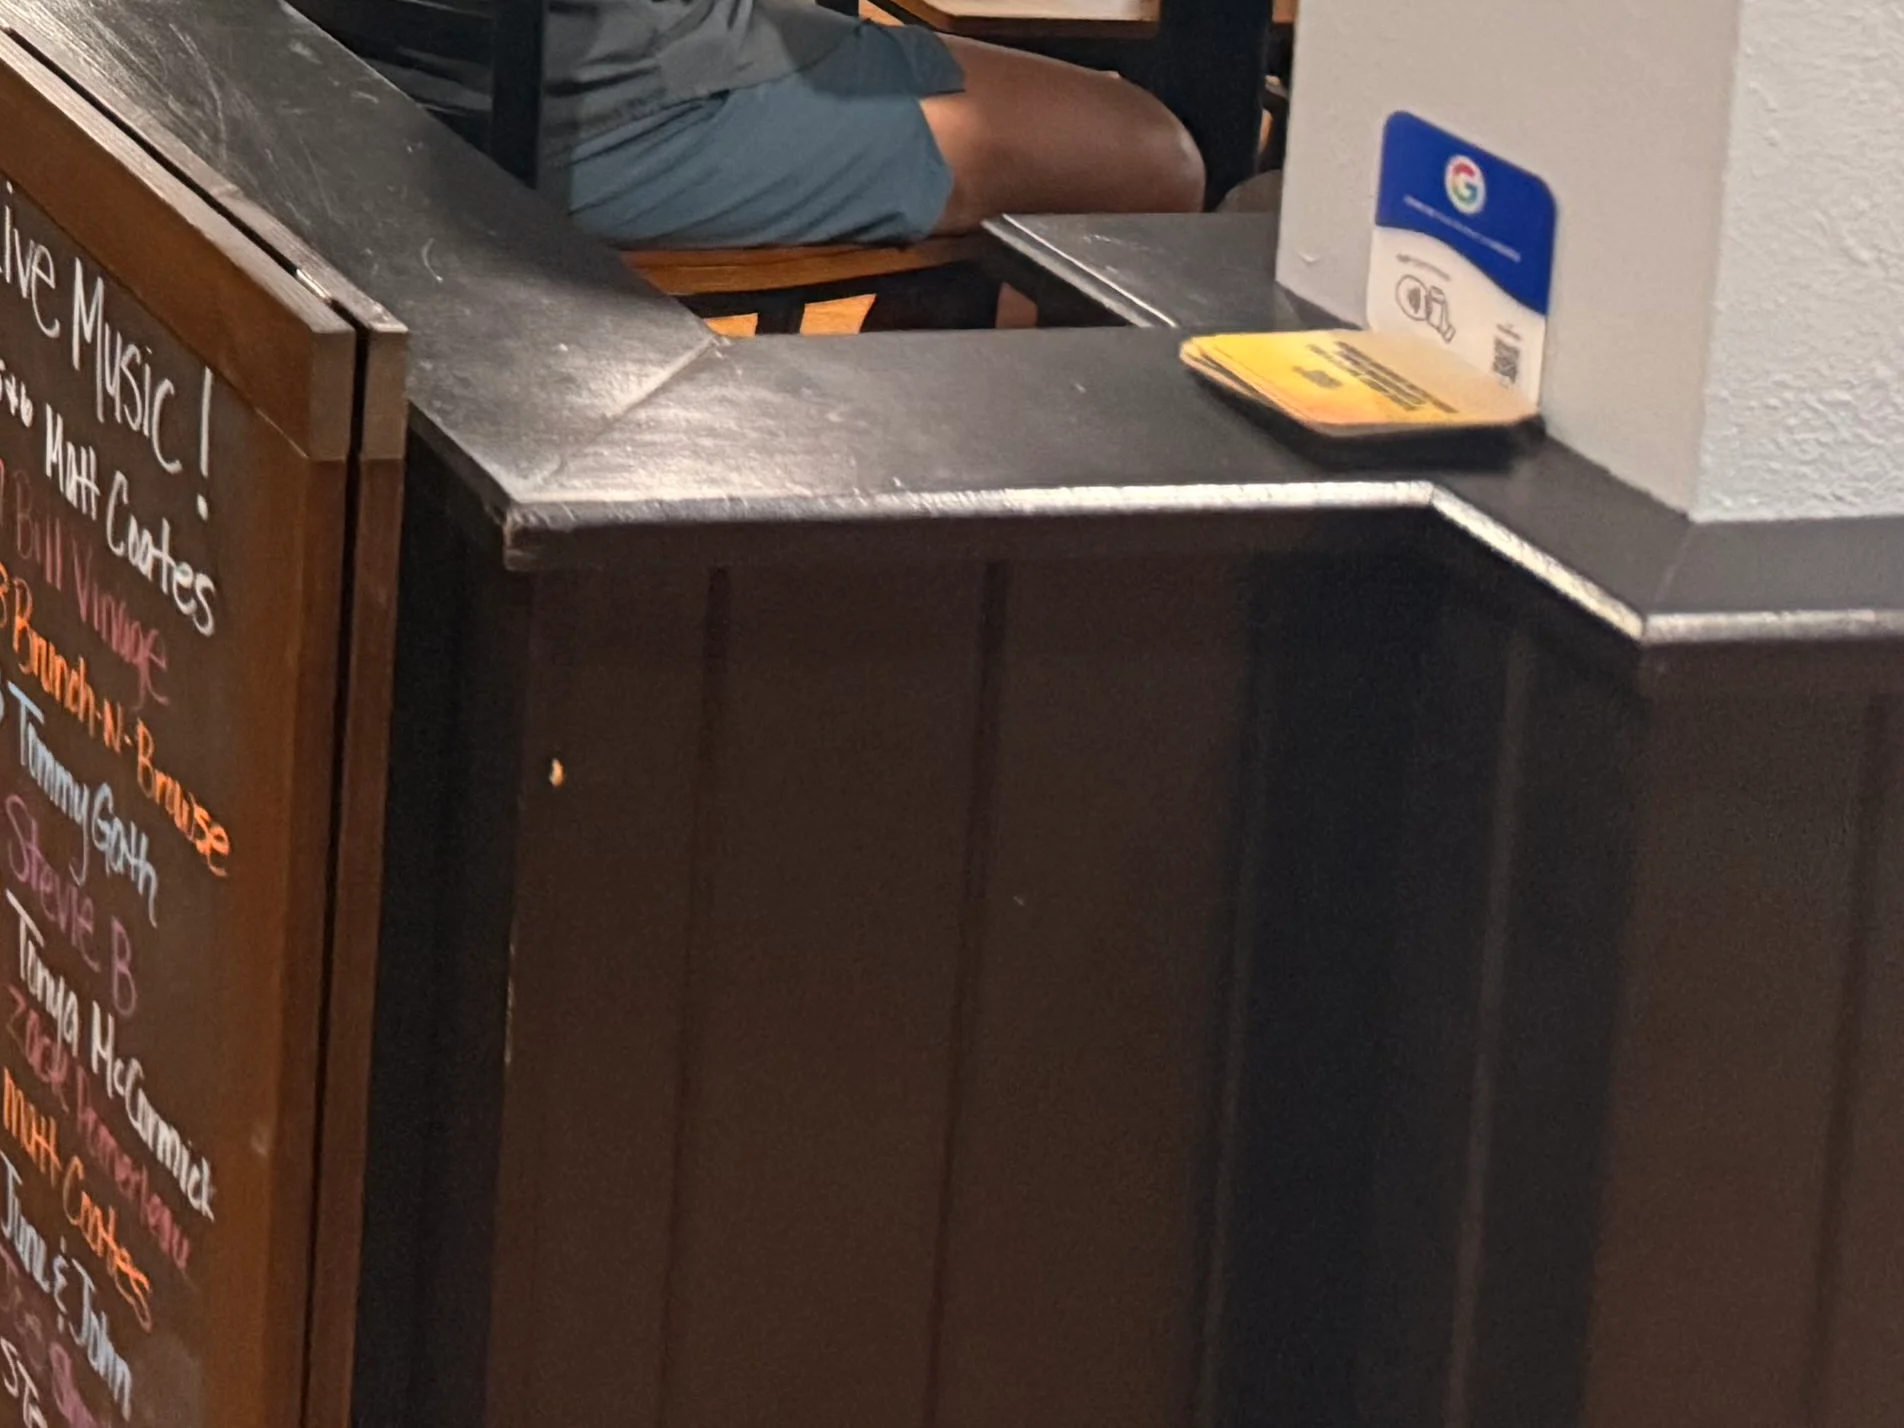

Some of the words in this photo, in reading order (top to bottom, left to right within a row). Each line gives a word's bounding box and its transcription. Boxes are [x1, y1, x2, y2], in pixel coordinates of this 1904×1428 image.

[107, 471, 215, 637] Coates
[7, 679, 91, 887] Tommy
[111, 915, 137, 1016] B
[69, 1258, 132, 1423] John
